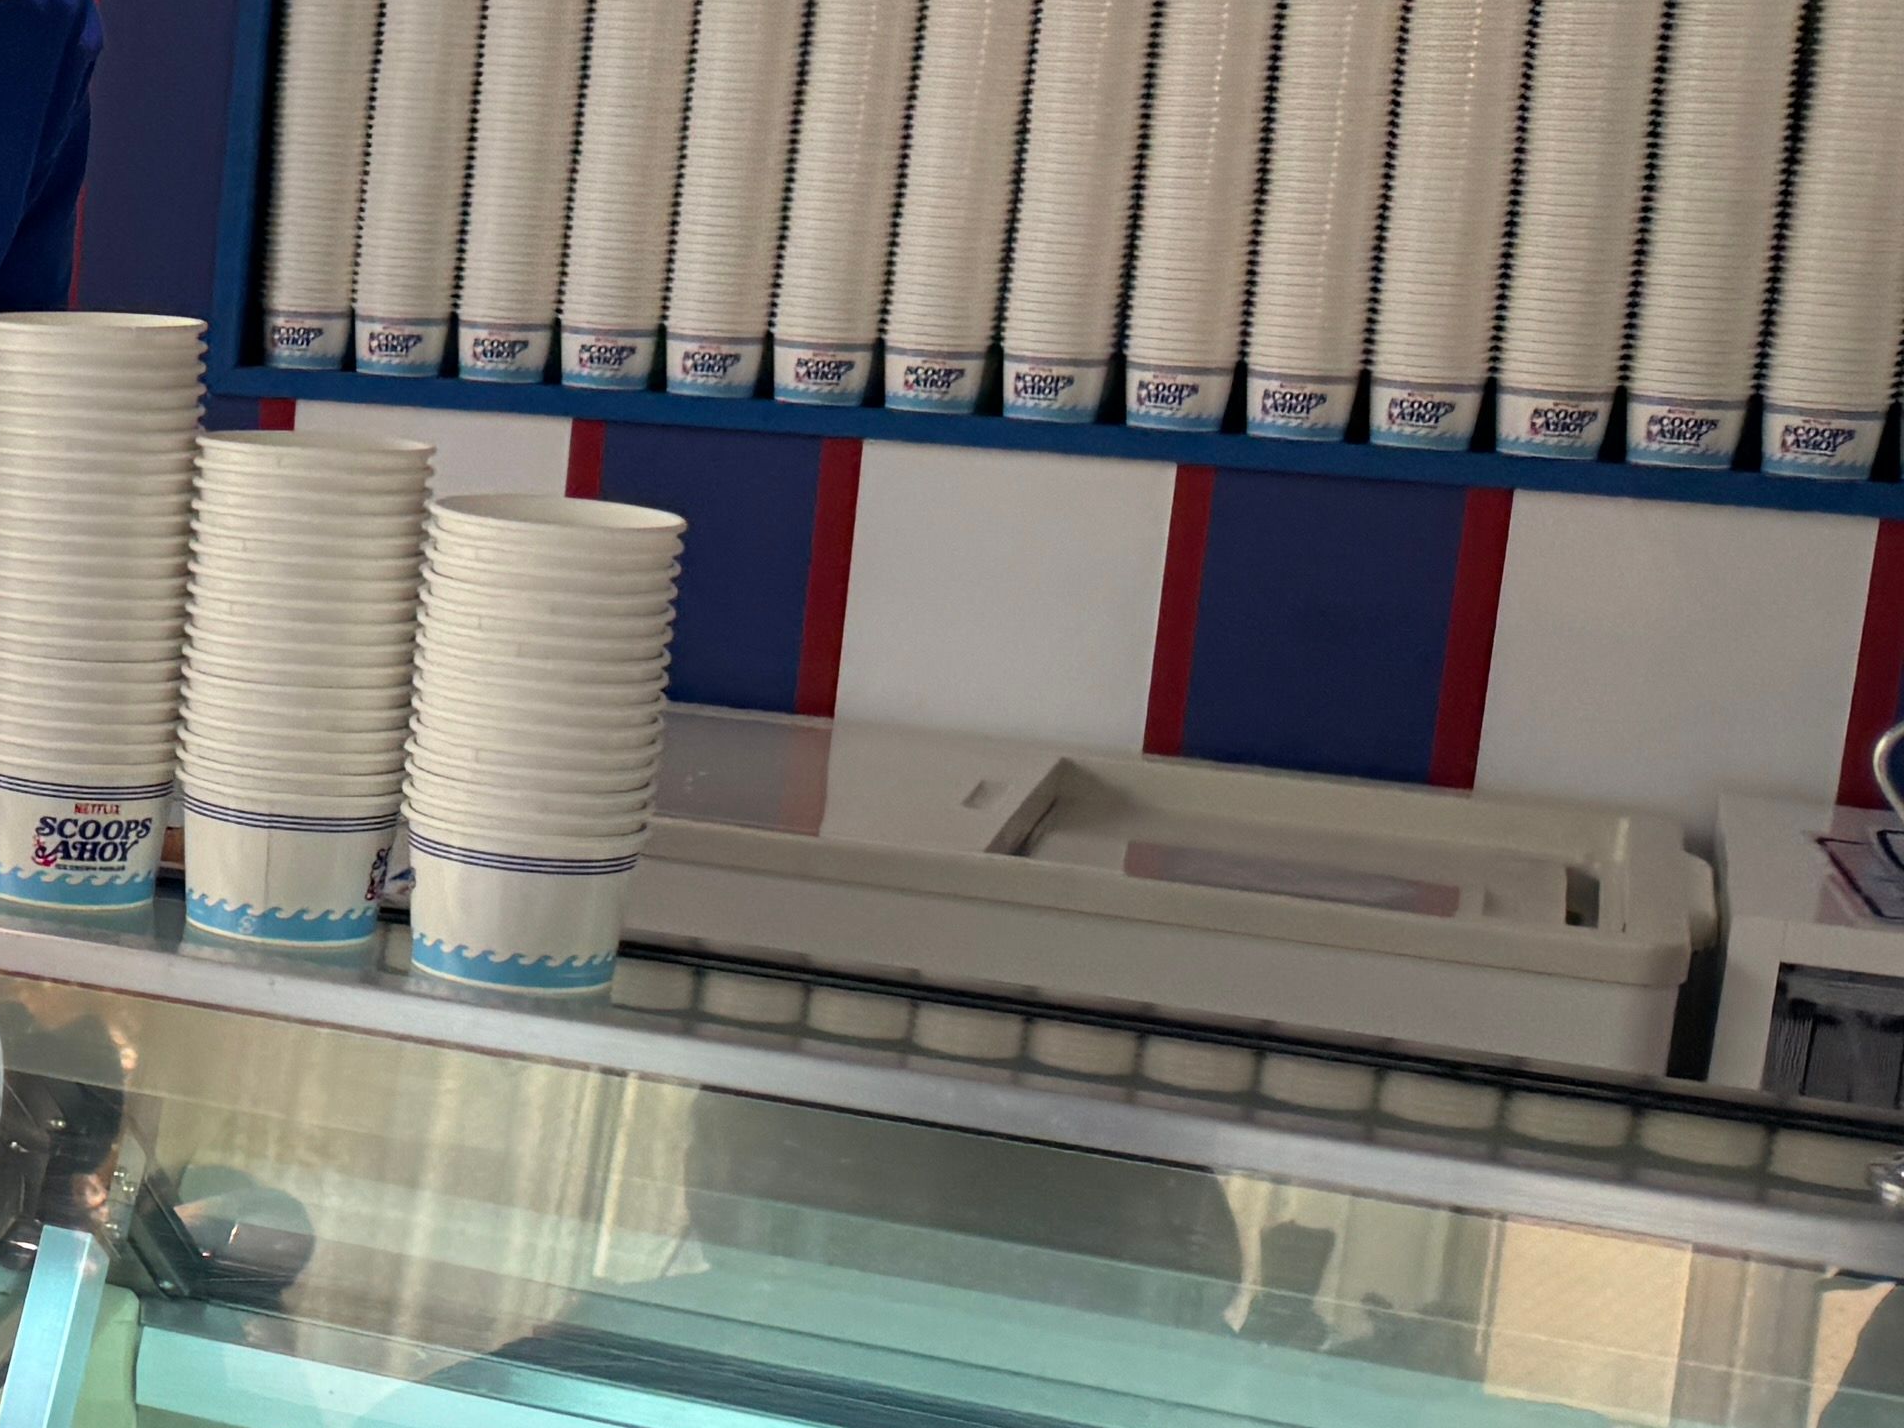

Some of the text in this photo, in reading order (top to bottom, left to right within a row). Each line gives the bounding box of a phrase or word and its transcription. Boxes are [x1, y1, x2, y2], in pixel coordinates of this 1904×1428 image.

[74, 803, 122, 816] NETFLIX
[35, 815, 153, 840] SCOOPS
[34, 839, 139, 863] AHOY
